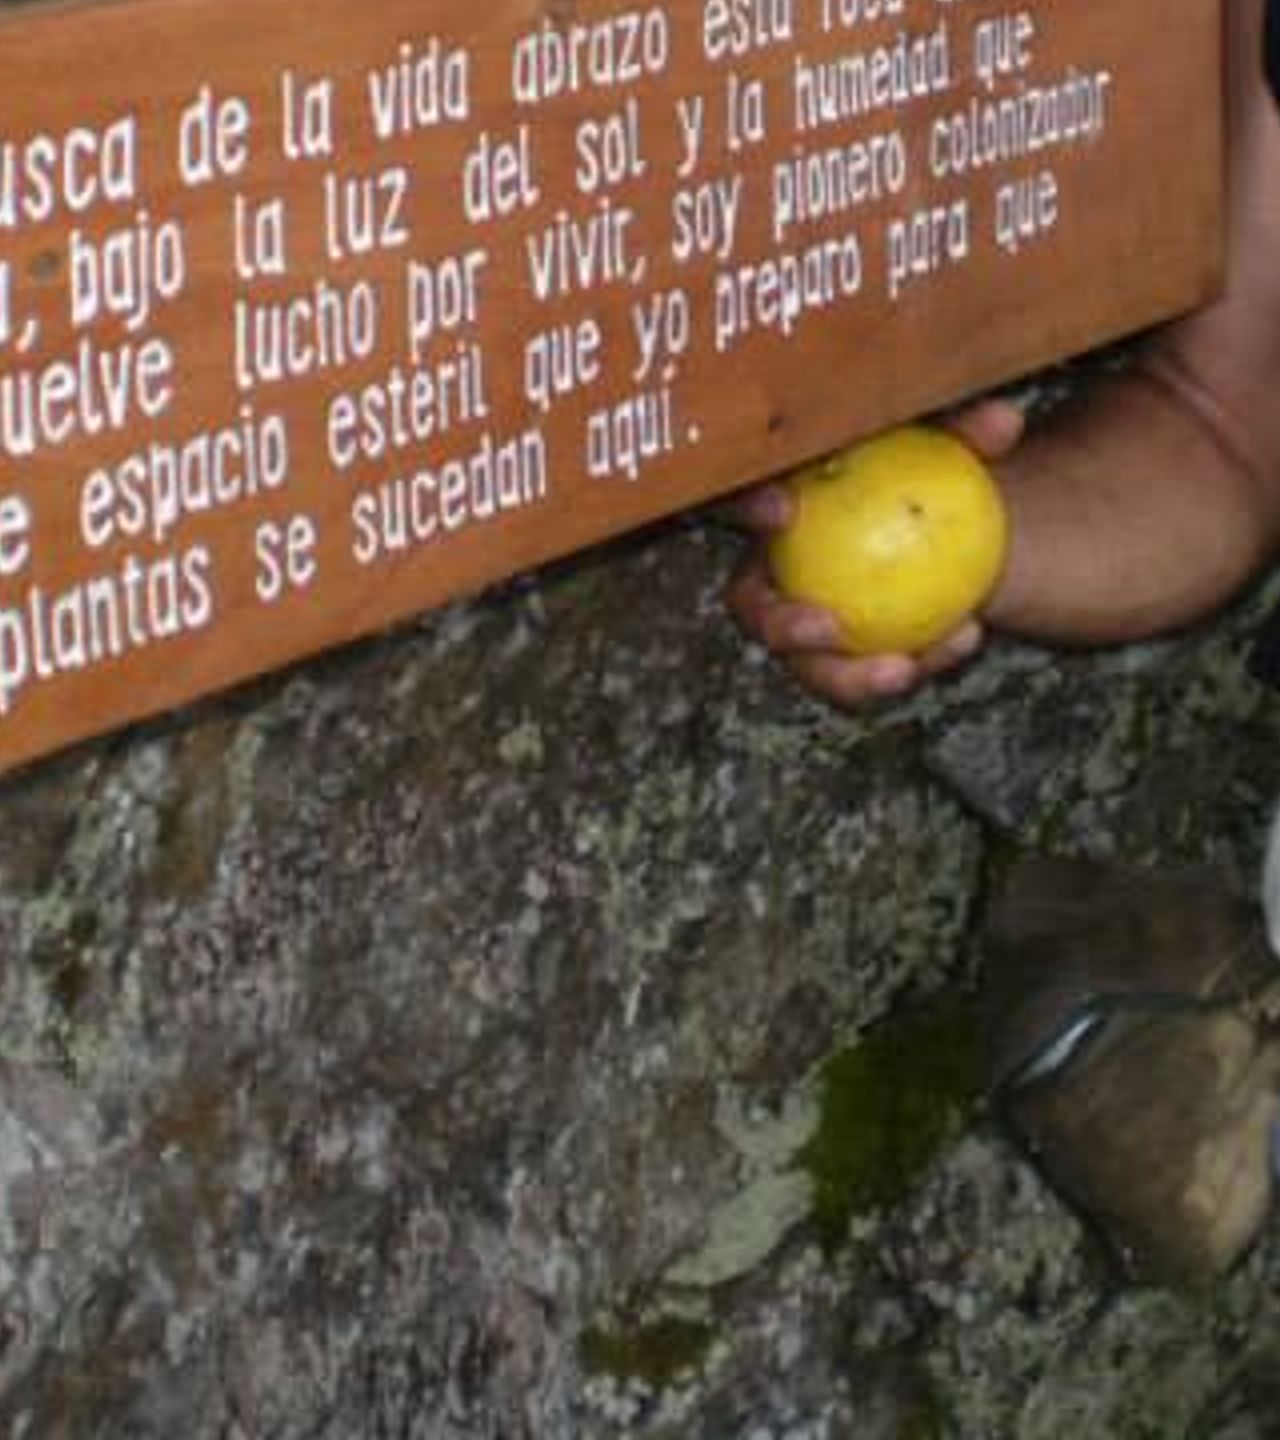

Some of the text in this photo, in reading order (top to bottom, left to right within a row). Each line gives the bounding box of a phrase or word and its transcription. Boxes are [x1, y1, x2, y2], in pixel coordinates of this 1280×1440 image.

[69, 208, 185, 332] bajo
[234, 194, 286, 280] la
[325, 167, 409, 260] luz
[463, 124, 540, 223] del
[575, 95, 647, 194] sol
[675, 95, 704, 177] y
[727, 74, 765, 151] la
[794, 20, 952, 131] humedad
[973, 12, 1035, 92] que
[179, 86, 250, 186] de
[282, 71, 334, 160] la
[368, 36, 469, 140] vida
[512, 8, 668, 103] abrazo
[80, 405, 288, 543] espacio
[524, 318, 602, 414] que
[632, 288, 690, 382] yo
[715, 231, 863, 353] preparo
[886, 197, 969, 299] para
[994, 169, 1059, 254] que
[234, 279, 376, 390] lucho
[407, 250, 488, 364] por
[526, 195, 647, 302] vivir,
[671, 174, 743, 260] soy
[773, 130, 907, 244] pionero
[255, 514, 317, 603] se
[351, 427, 547, 564] sucedan
